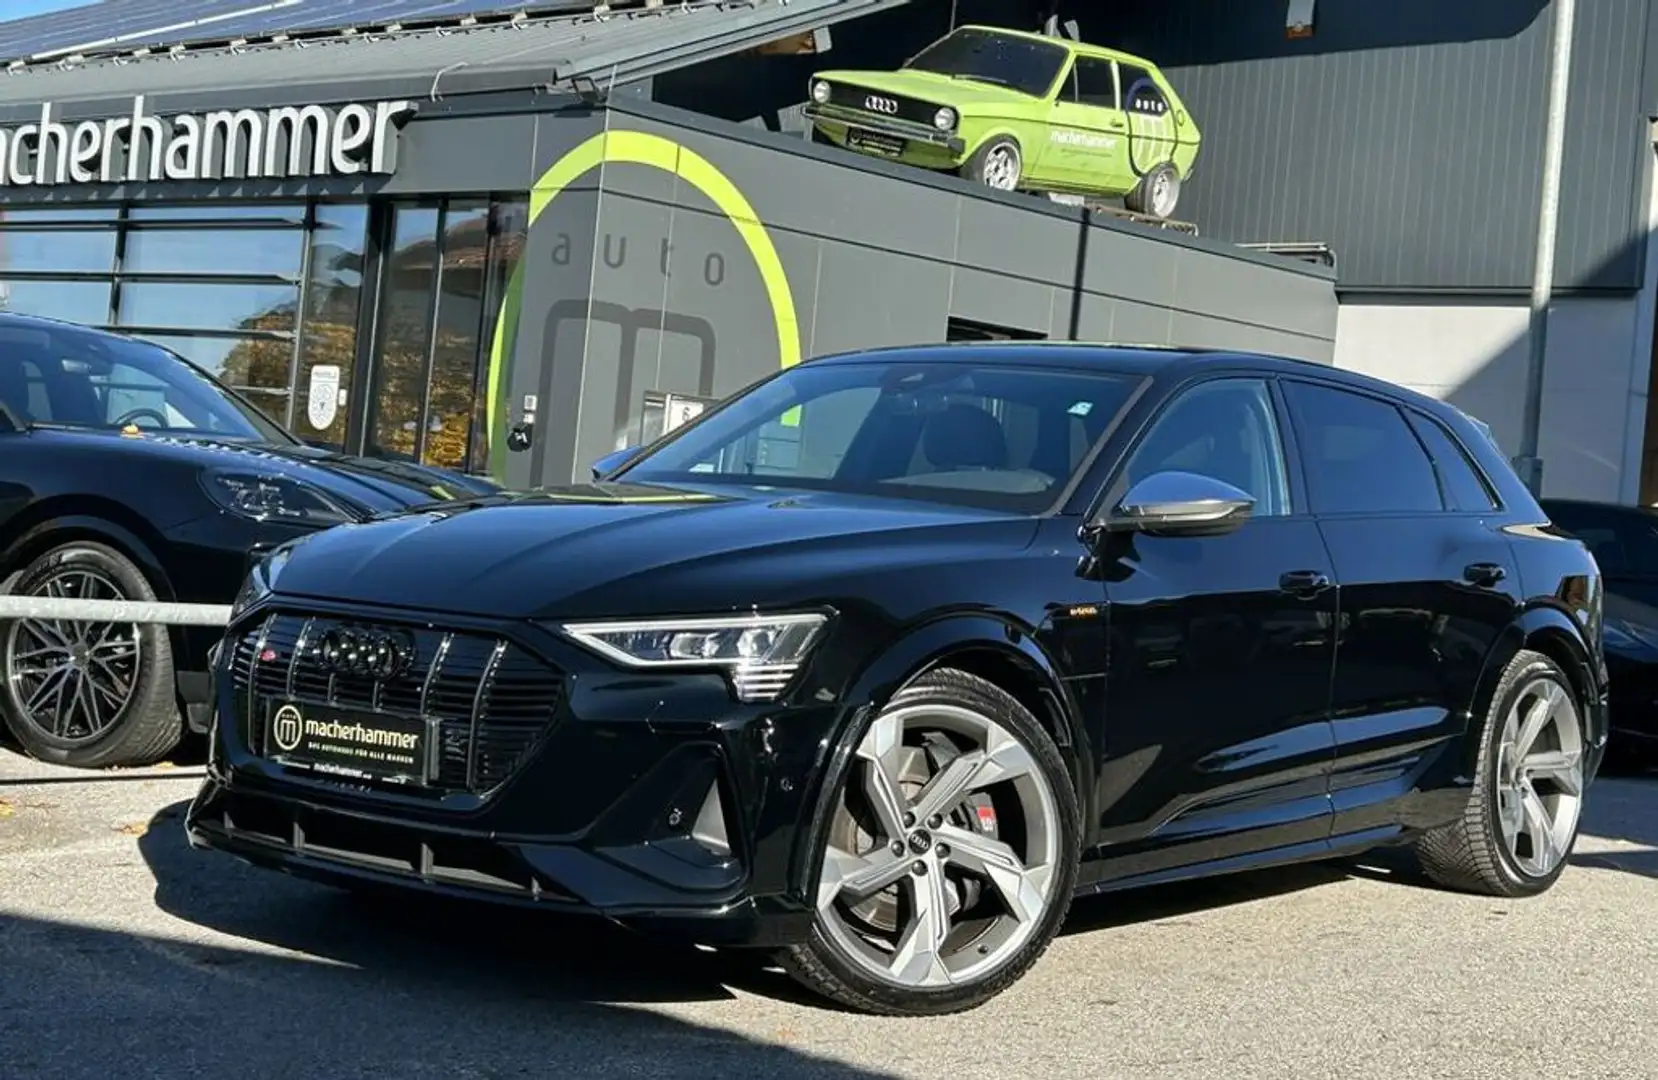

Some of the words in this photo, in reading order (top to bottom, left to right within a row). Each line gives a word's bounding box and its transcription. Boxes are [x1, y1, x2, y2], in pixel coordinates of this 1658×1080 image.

[0, 95, 414, 185] cherhammer
[552, 233, 725, 286] auto
[305, 719, 418, 750] macherhammer
